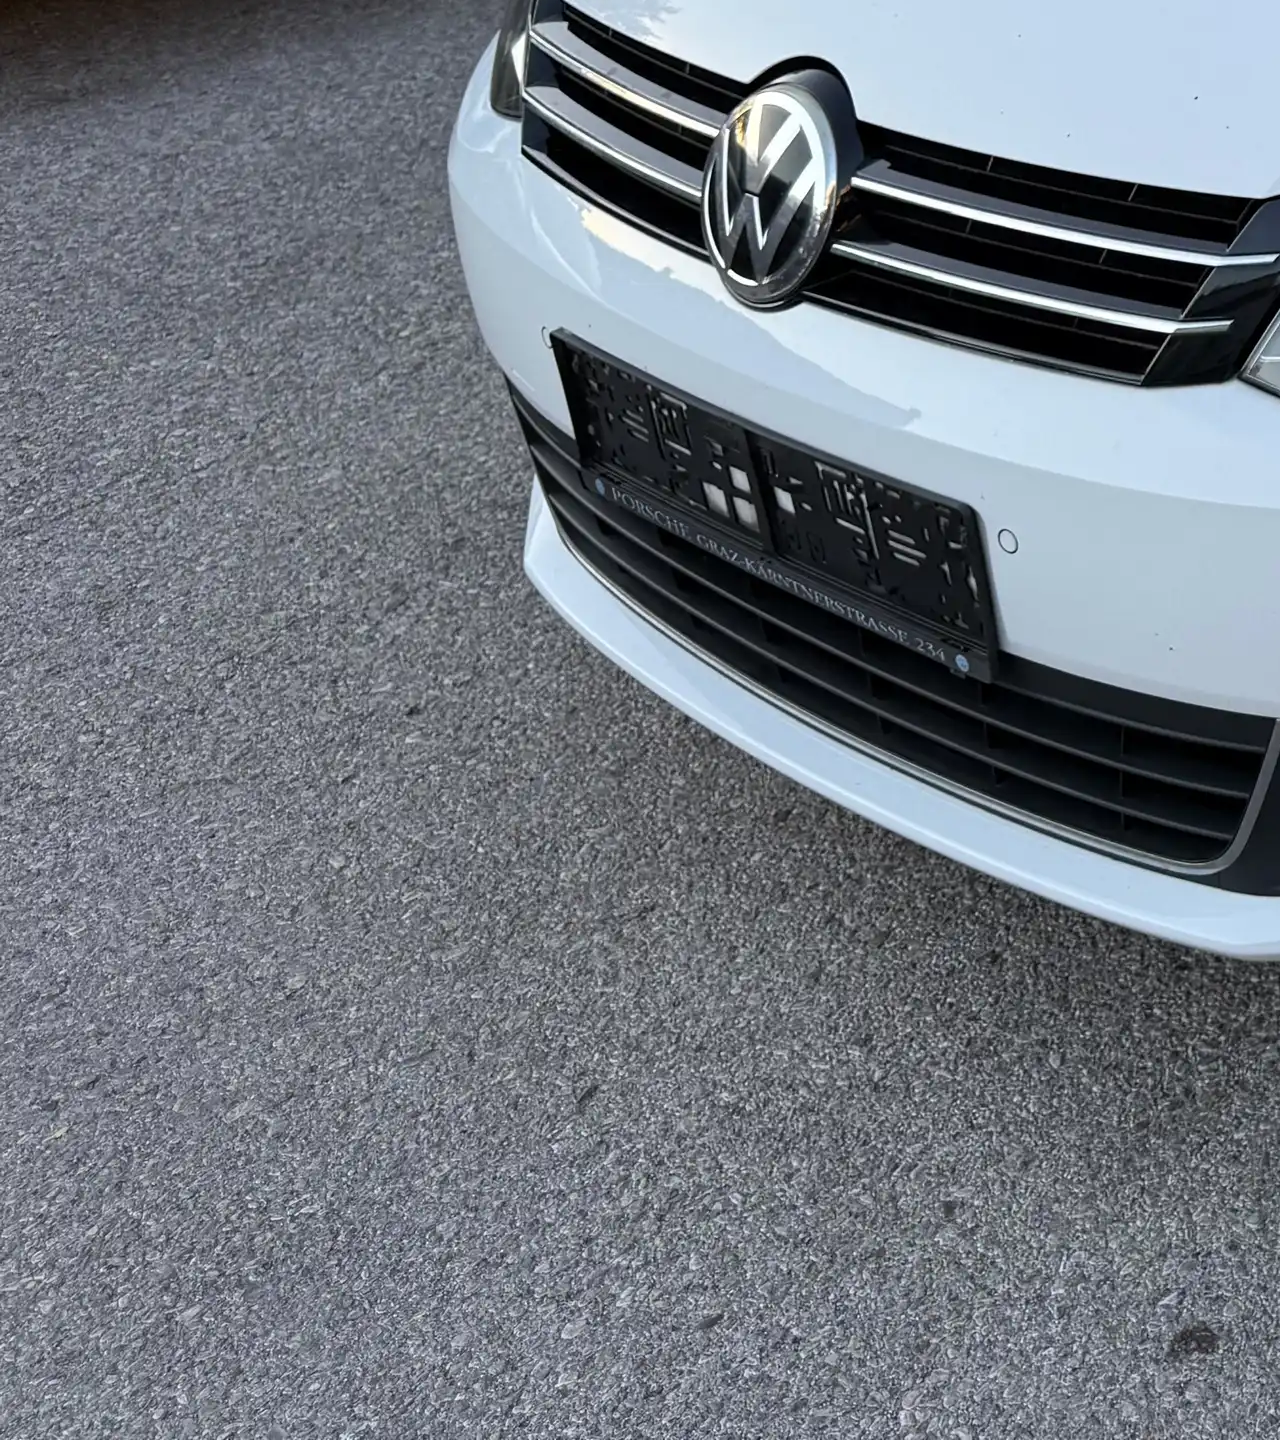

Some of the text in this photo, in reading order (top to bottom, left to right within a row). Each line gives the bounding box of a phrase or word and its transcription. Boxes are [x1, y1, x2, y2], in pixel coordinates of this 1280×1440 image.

[702, 88, 836, 292] VW
[611, 487, 692, 540] PORSCHE
[914, 637, 946, 661] 234
